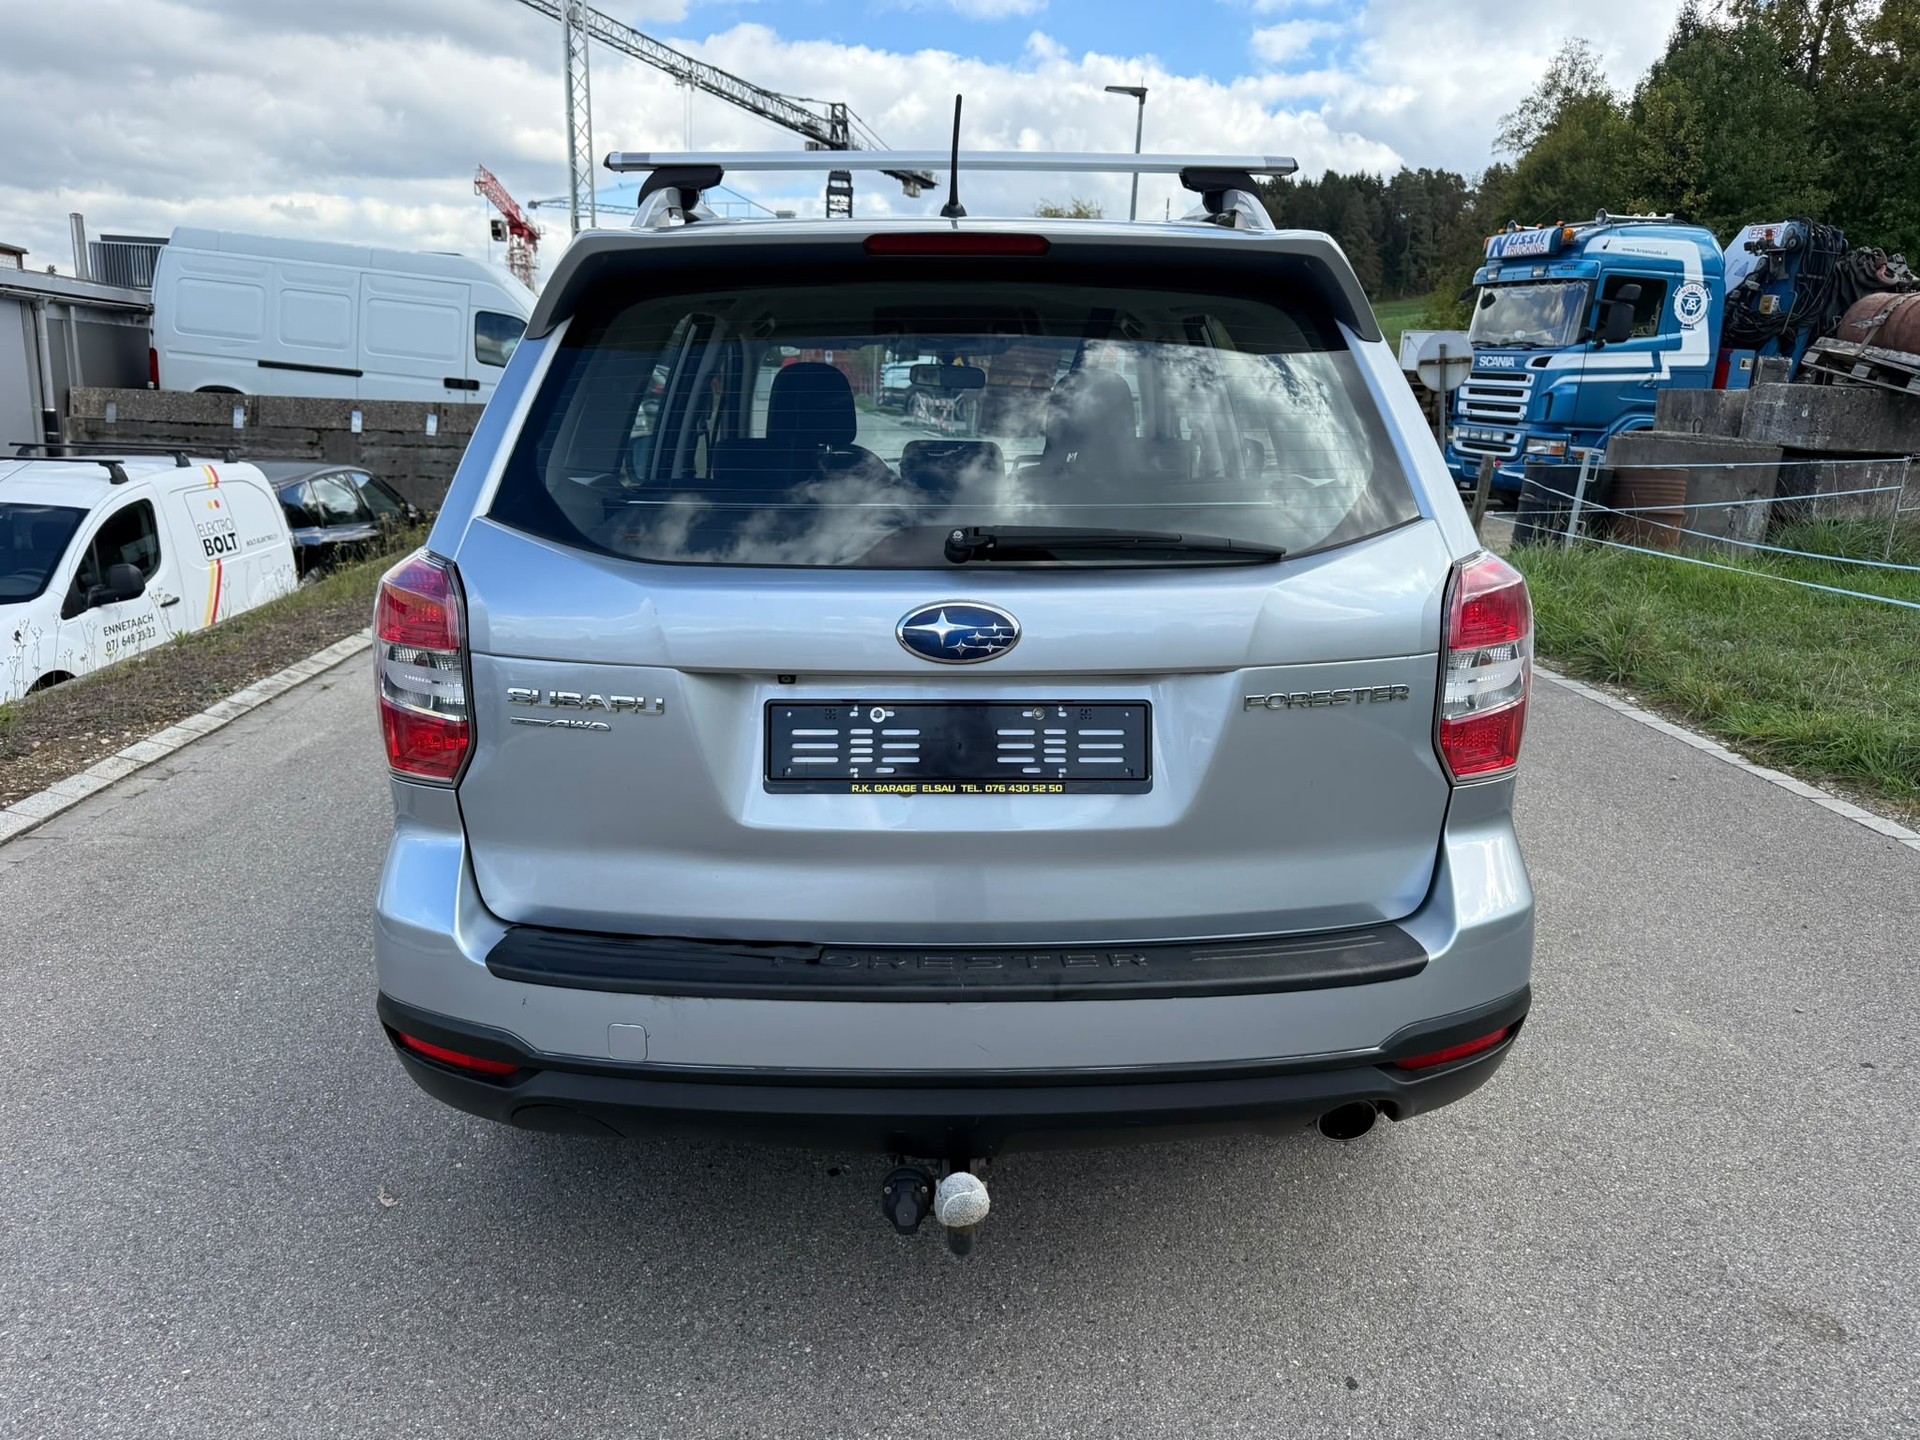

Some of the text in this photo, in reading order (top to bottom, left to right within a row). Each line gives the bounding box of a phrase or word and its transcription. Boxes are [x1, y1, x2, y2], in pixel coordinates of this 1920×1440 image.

[1751, 228, 1779, 237] FASI
[1507, 243, 1545, 255] TRUCKING
[1479, 356, 1515, 368] SCANIA
[197, 517, 234, 538] ELEKTRO
[203, 532, 238, 557] BOLT
[103, 613, 154, 636] ENNETAACH
[507, 687, 665, 716] SUBARU
[1244, 683, 1411, 712] FORESTER
[547, 719, 612, 732] AWD
[851, 784, 1063, 793] R.K. GARAGE ELSAU TEL. 076 430 52 50
